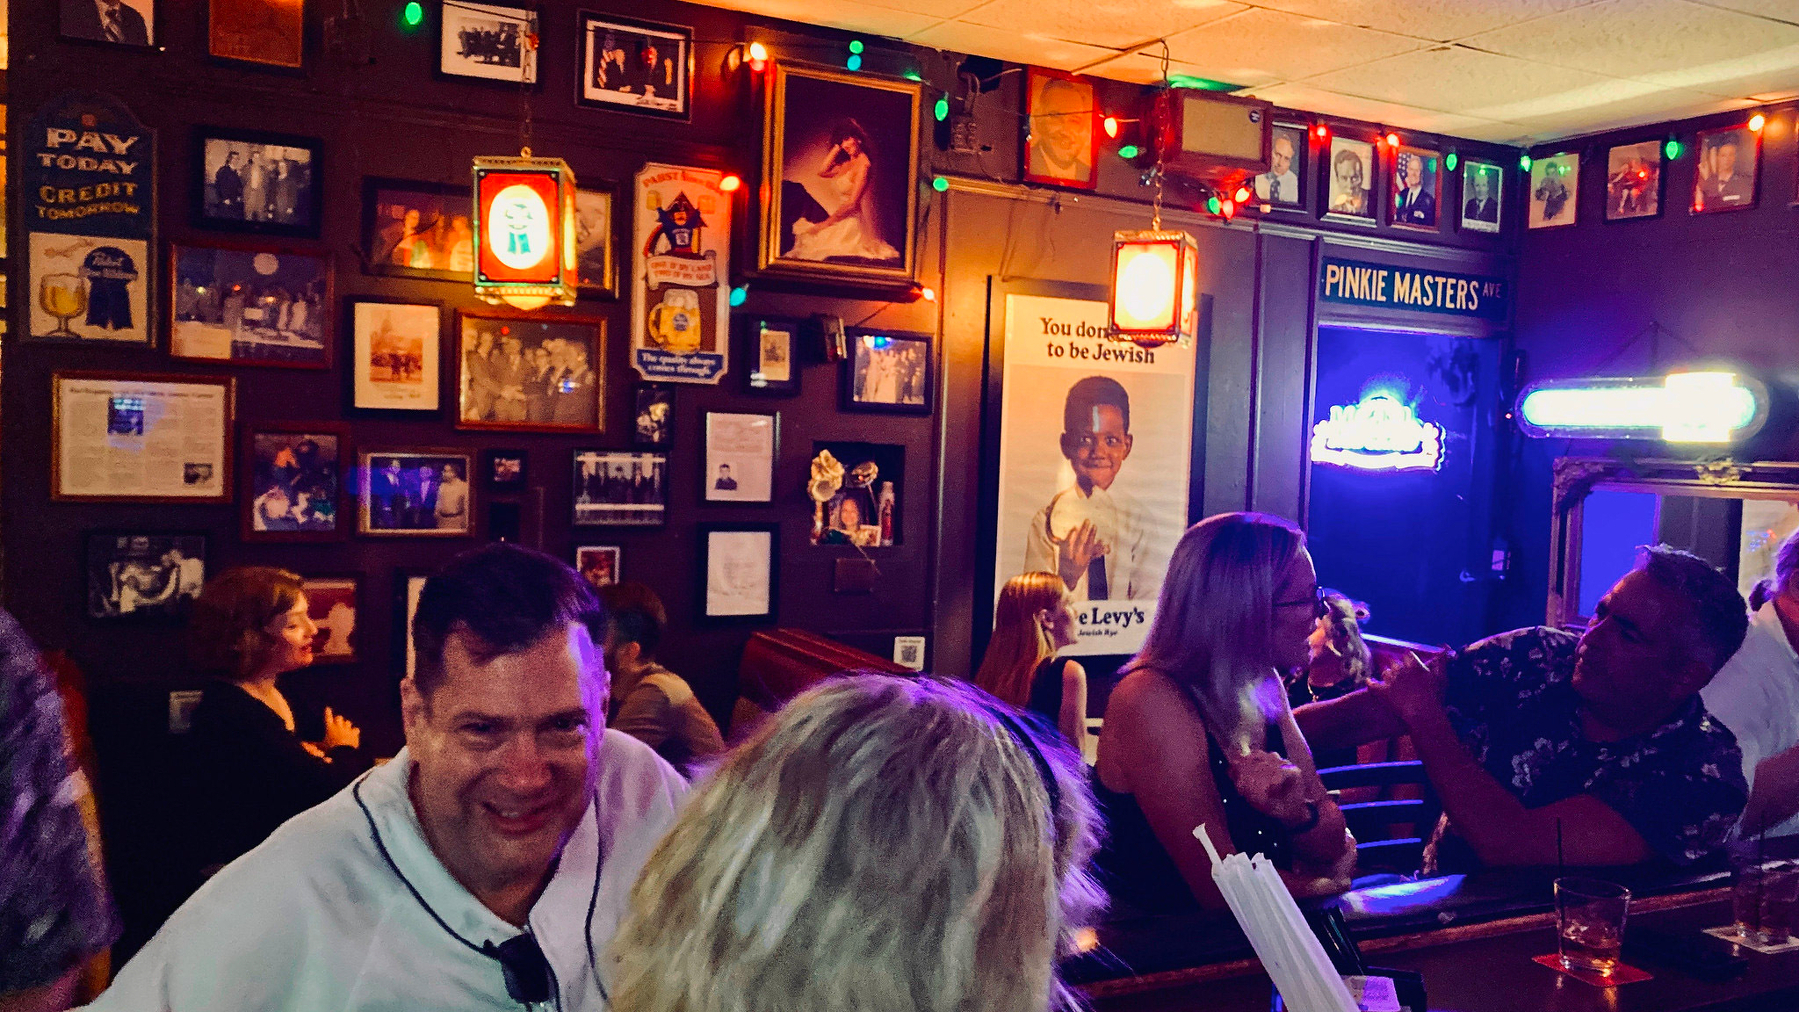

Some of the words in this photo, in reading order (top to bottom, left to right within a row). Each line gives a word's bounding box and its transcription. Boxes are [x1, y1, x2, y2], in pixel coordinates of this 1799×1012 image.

[46, 127, 139, 155] PAY
[36, 153, 139, 175] TODAY
[40, 182, 139, 203] CREDIT
[35, 202, 140, 220] TOMORROW
[1325, 264, 1388, 302] PINKIE
[1393, 271, 1479, 311] MASTERS
[1482, 281, 1503, 299] AVE
[1040, 317, 1071, 337] You
[1076, 320, 1109, 339] don
[1047, 342, 1065, 357] to
[1069, 341, 1090, 359] be
[1092, 343, 1155, 364] Jewish
[1091, 606, 1145, 628] Levy's
[1078, 629, 1103, 637] Jewish
[1104, 629, 1118, 638] Rye
